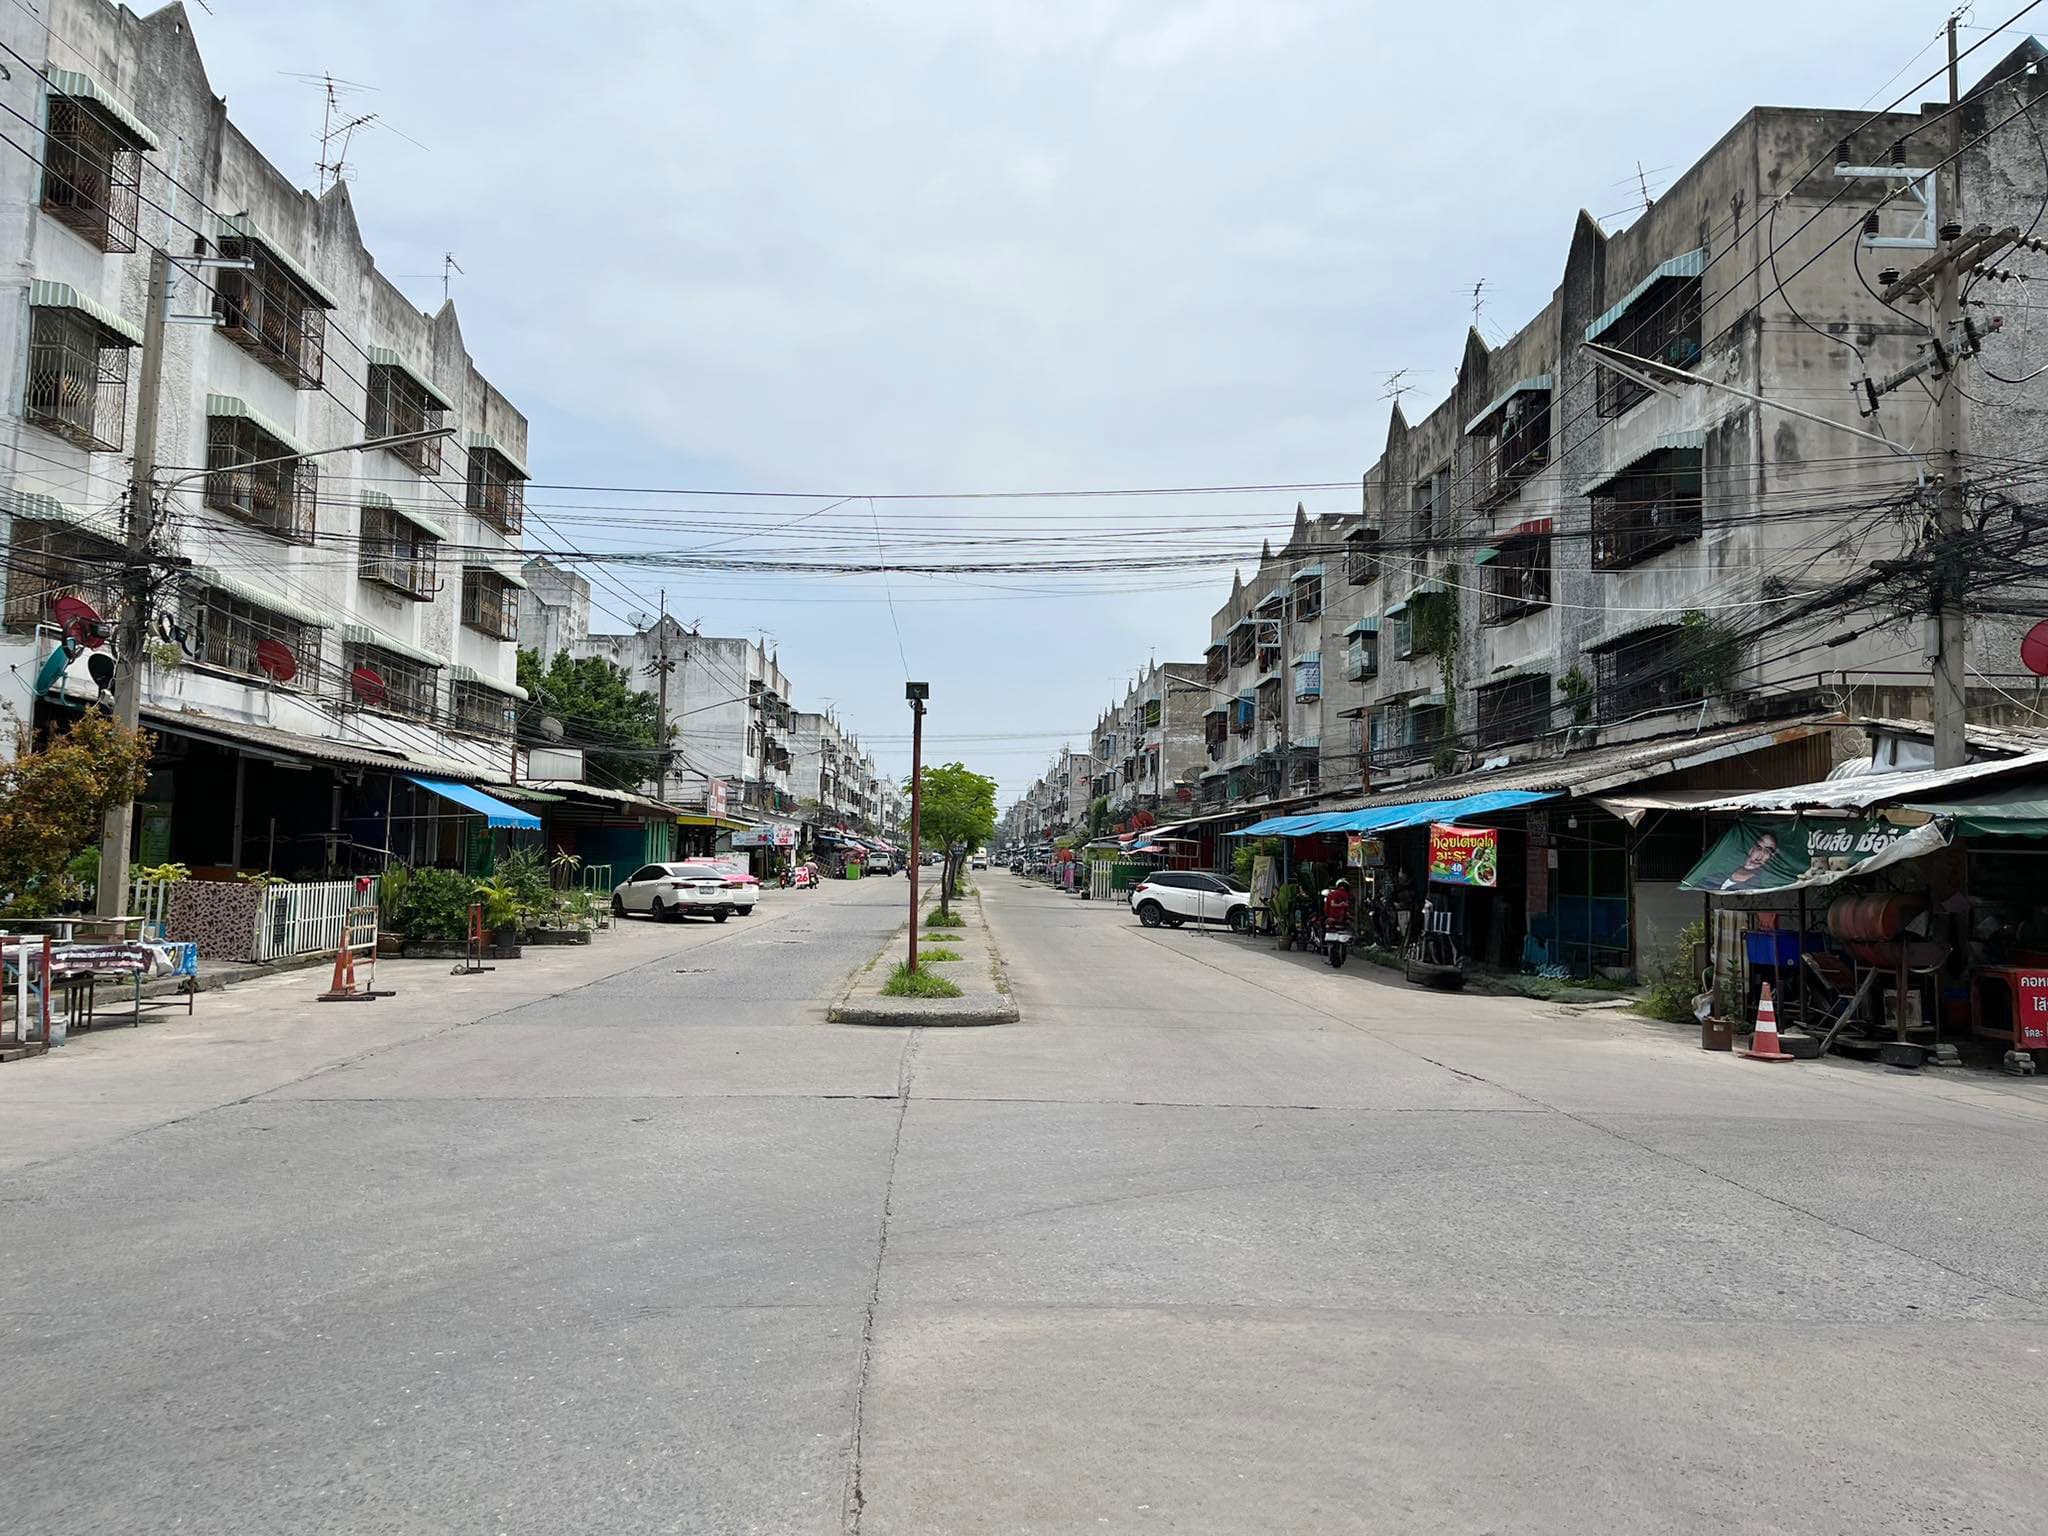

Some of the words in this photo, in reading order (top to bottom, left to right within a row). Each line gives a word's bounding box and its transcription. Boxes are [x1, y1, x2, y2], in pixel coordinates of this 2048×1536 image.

[1437, 851, 1466, 861] มะระ
[1451, 863, 1462, 872] 40
[796, 873, 808, 882] 26
[2021, 976, 2048, 987] คอห
[2032, 996, 2048, 1011] ไส้
